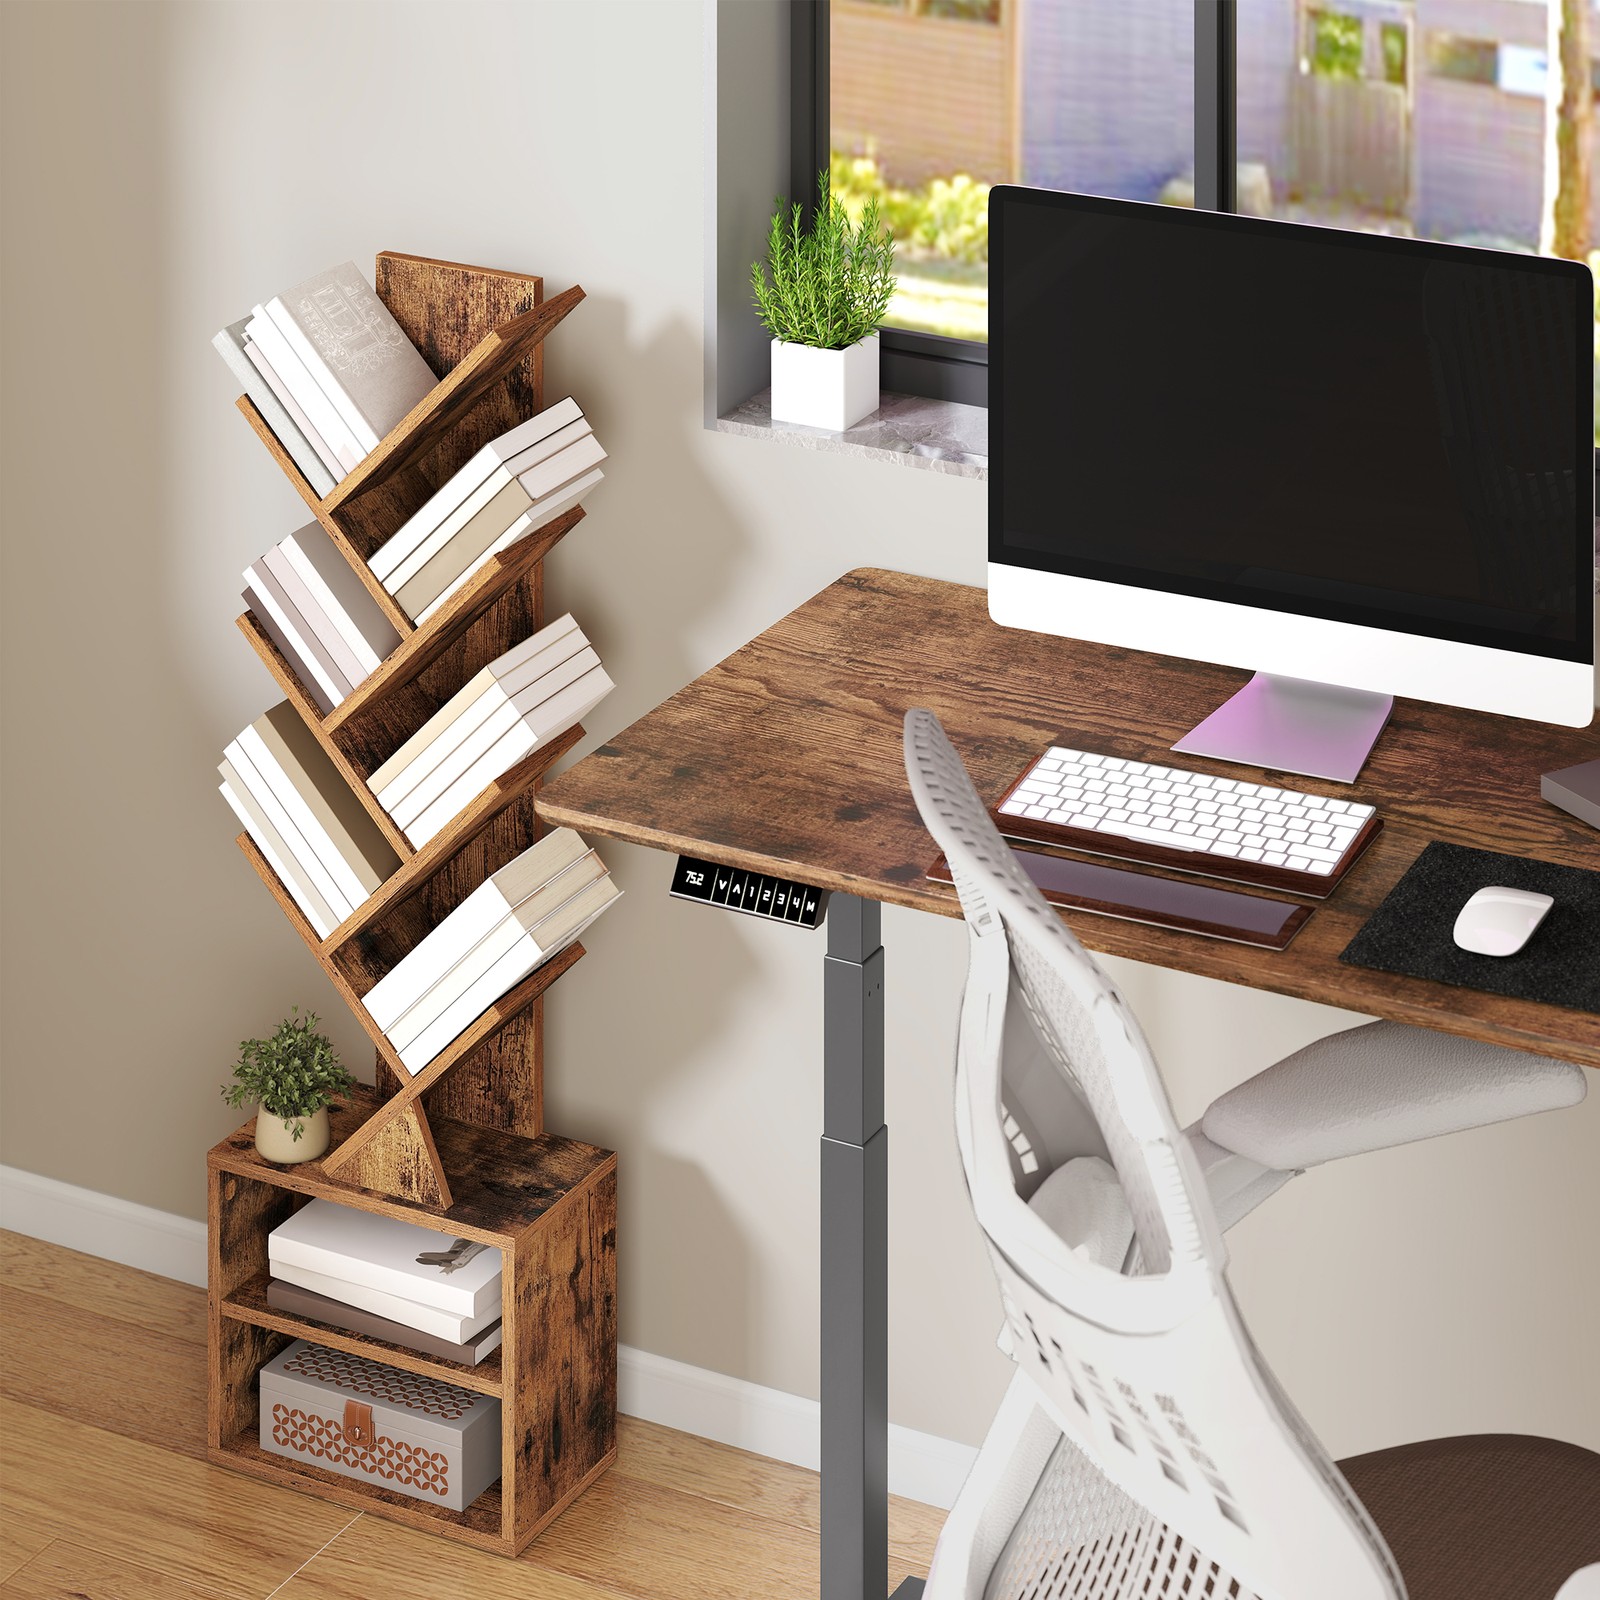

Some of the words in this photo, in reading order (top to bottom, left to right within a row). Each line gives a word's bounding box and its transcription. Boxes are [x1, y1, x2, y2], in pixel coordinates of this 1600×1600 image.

[750, 886, 755, 898] 1
[762, 889, 771, 901] 2
[776, 893, 785, 905] 3
[792, 896, 800, 909] 4
[806, 901, 815, 913] M
